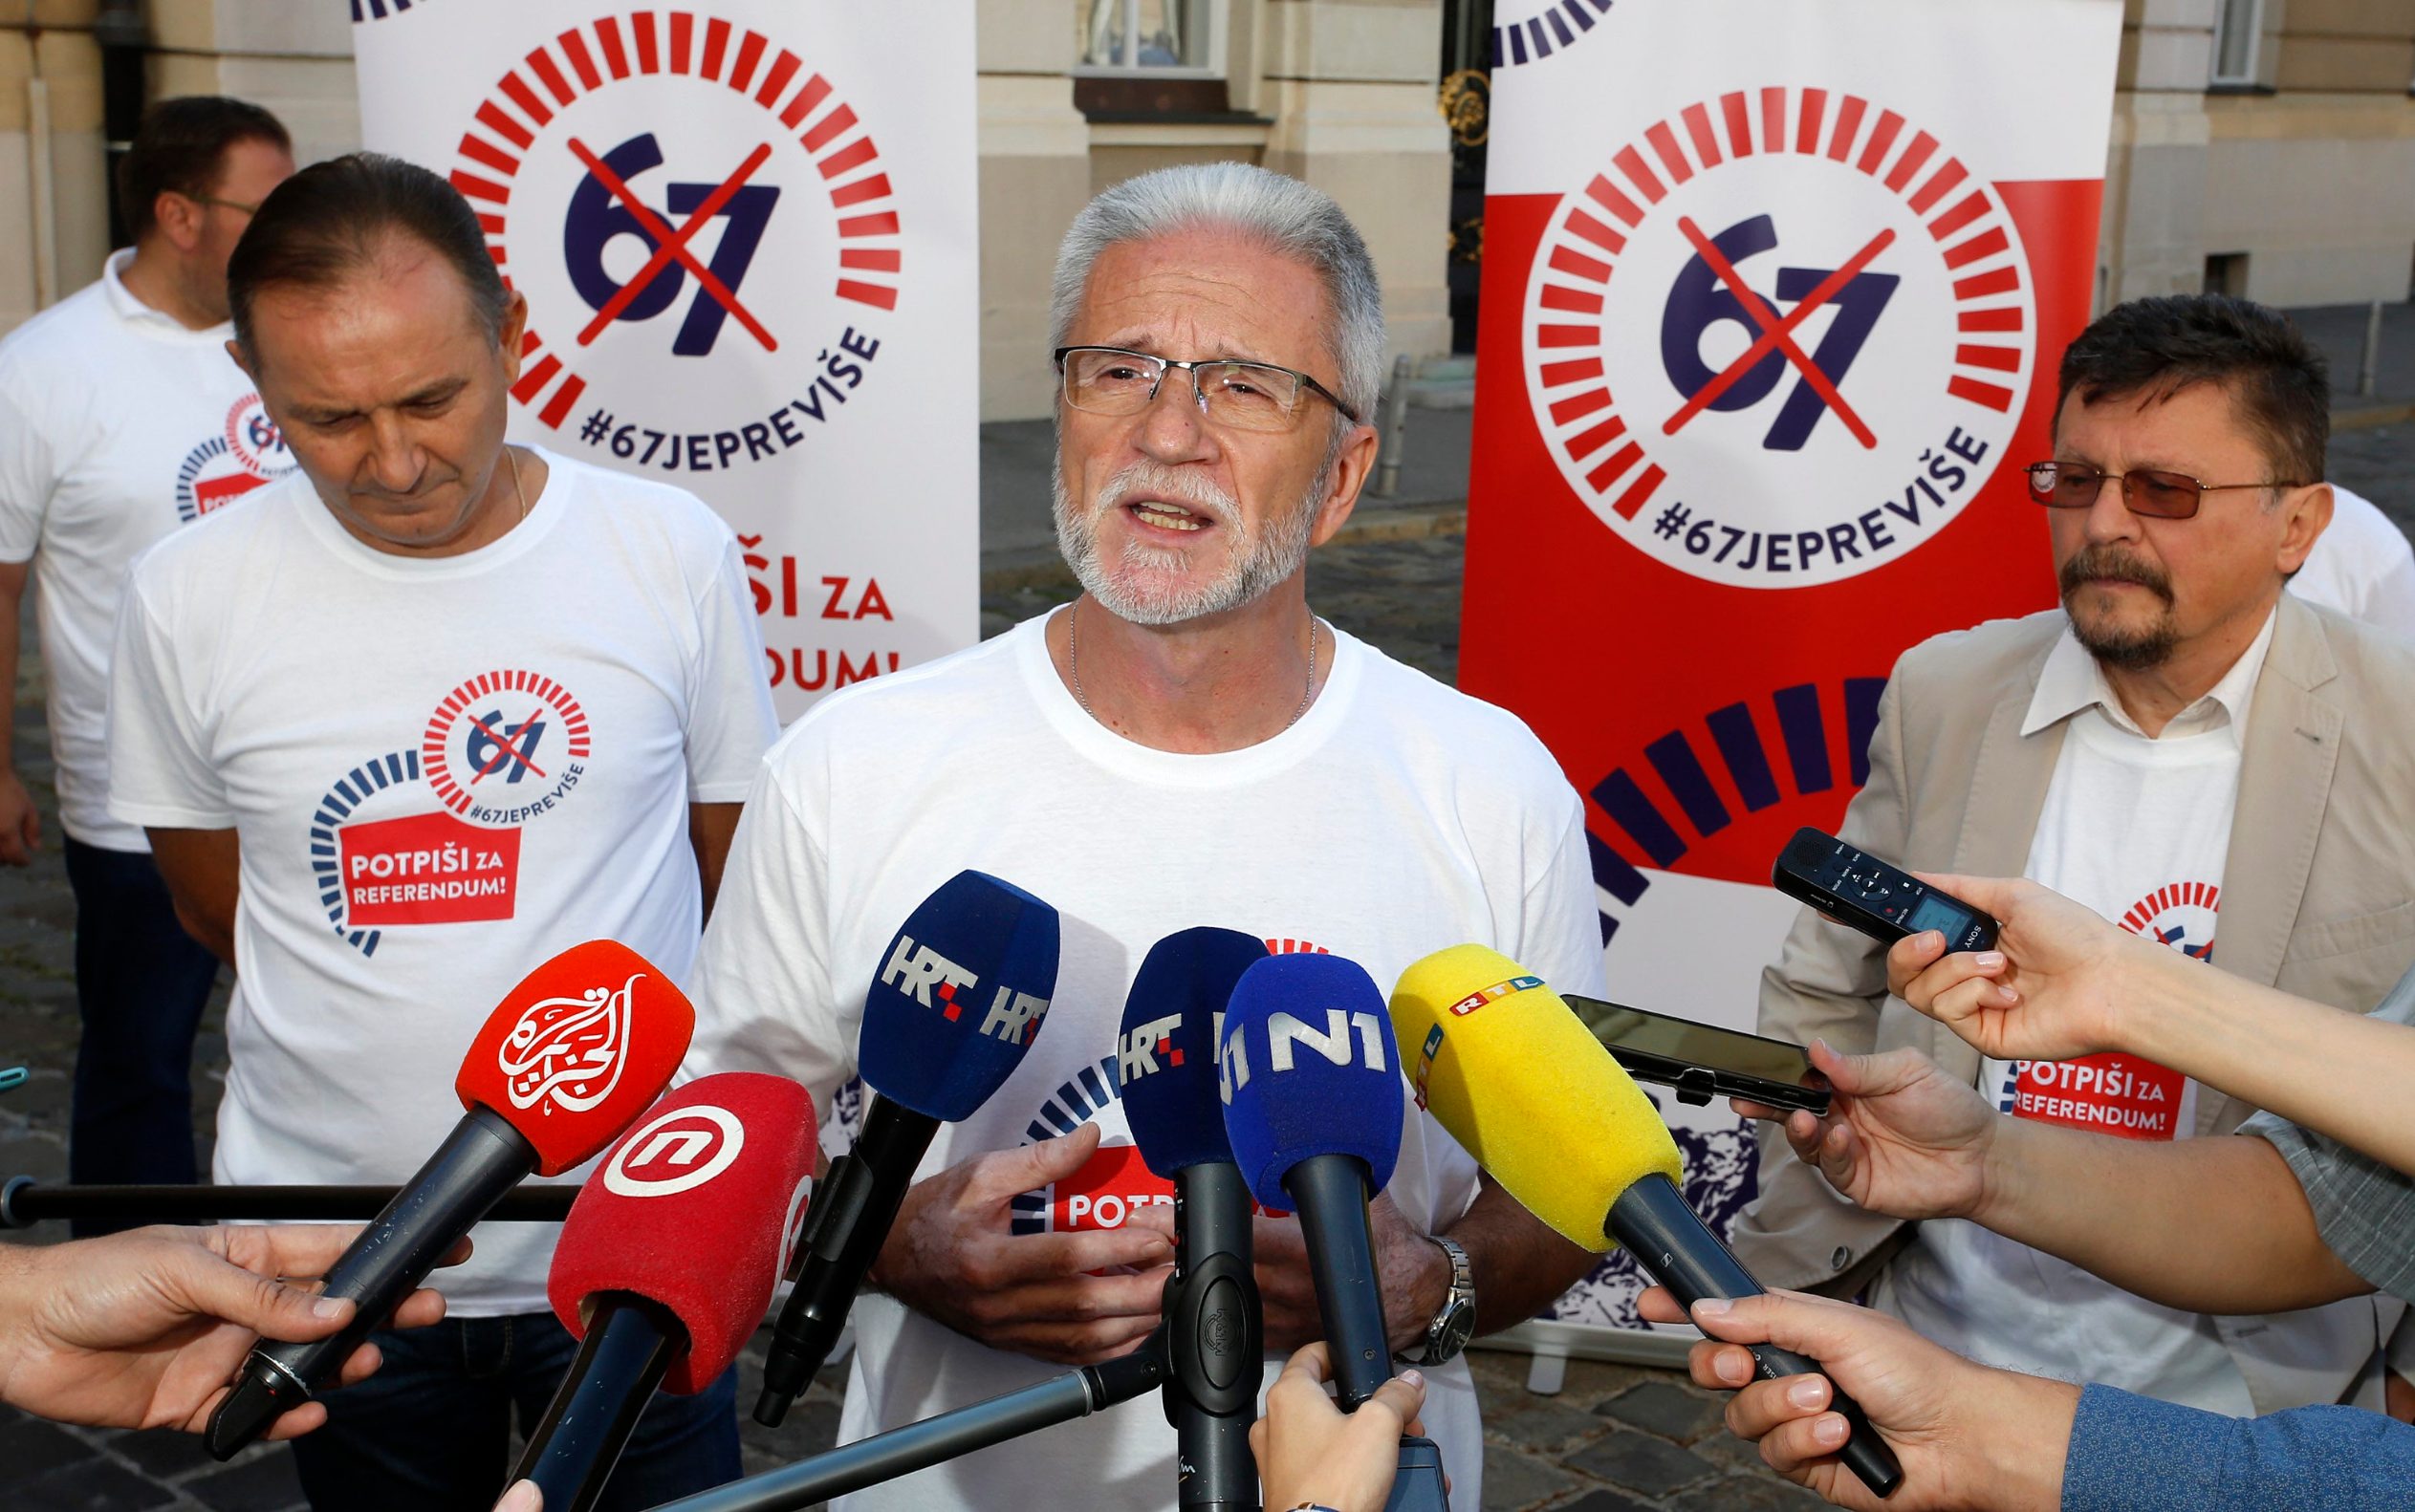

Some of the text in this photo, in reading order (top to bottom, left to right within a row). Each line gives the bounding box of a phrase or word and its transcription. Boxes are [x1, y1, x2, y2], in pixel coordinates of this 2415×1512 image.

[564, 132, 781, 356] 67
[1661, 213, 1900, 451] 67
[579, 327, 881, 472] #67JEPREVIŠE
[1652, 426, 1990, 572] #67JEPREVIŠE
[820, 576, 894, 621] ZA
[467, 708, 547, 785] 67
[470, 763, 584, 823] #67JEPREVIŠE
[350, 841, 504, 879] POTPIŠI ZA
[353, 877, 507, 905] REFERENDUM!
[1965, 925, 1982, 948] SONY
[881, 935, 979, 1023] HRT
[1452, 978, 1541, 1015] RTL
[1120, 1013, 1185, 1087] HRT
[1267, 1009, 1386, 1072] N1
[2137, 1081, 2165, 1102] ZA
